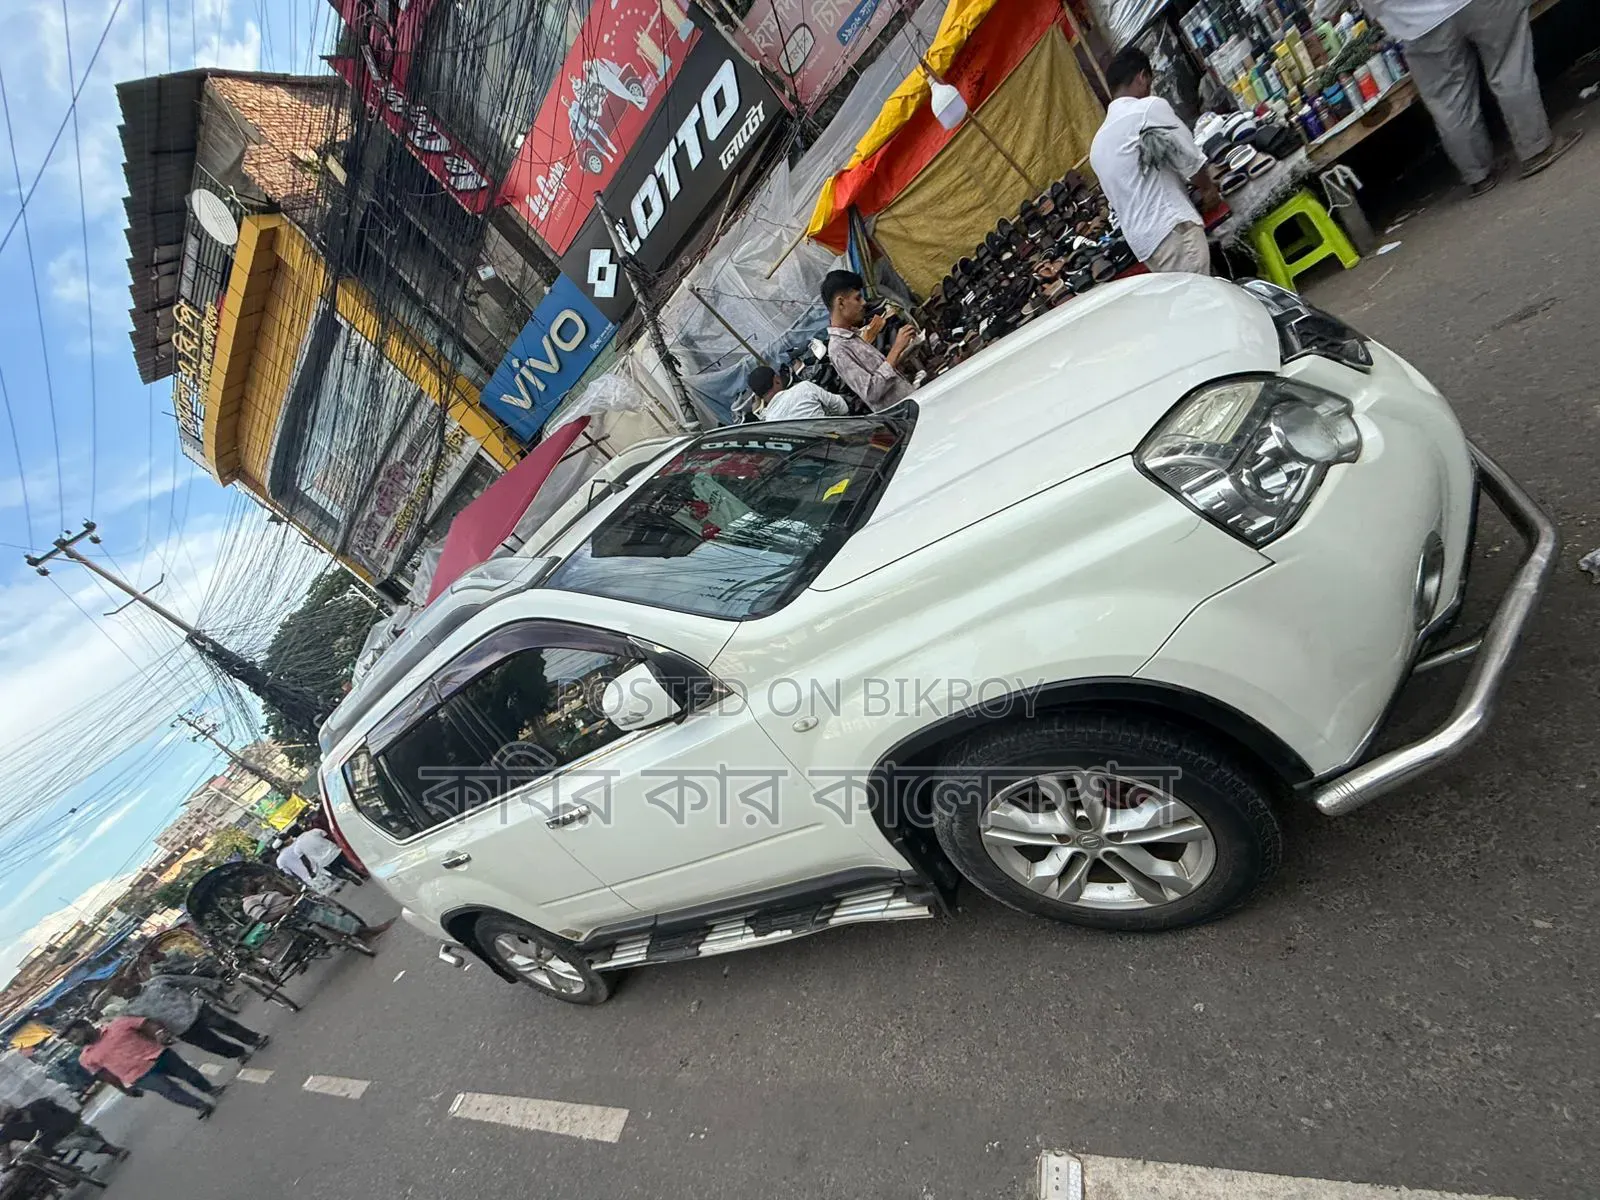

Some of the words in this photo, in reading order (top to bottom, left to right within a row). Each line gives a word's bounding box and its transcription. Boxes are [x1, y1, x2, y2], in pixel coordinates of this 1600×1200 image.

[614, 58, 740, 256] LOTTO
[718, 100, 766, 171] লোটো
[500, 309, 587, 410] vivo
